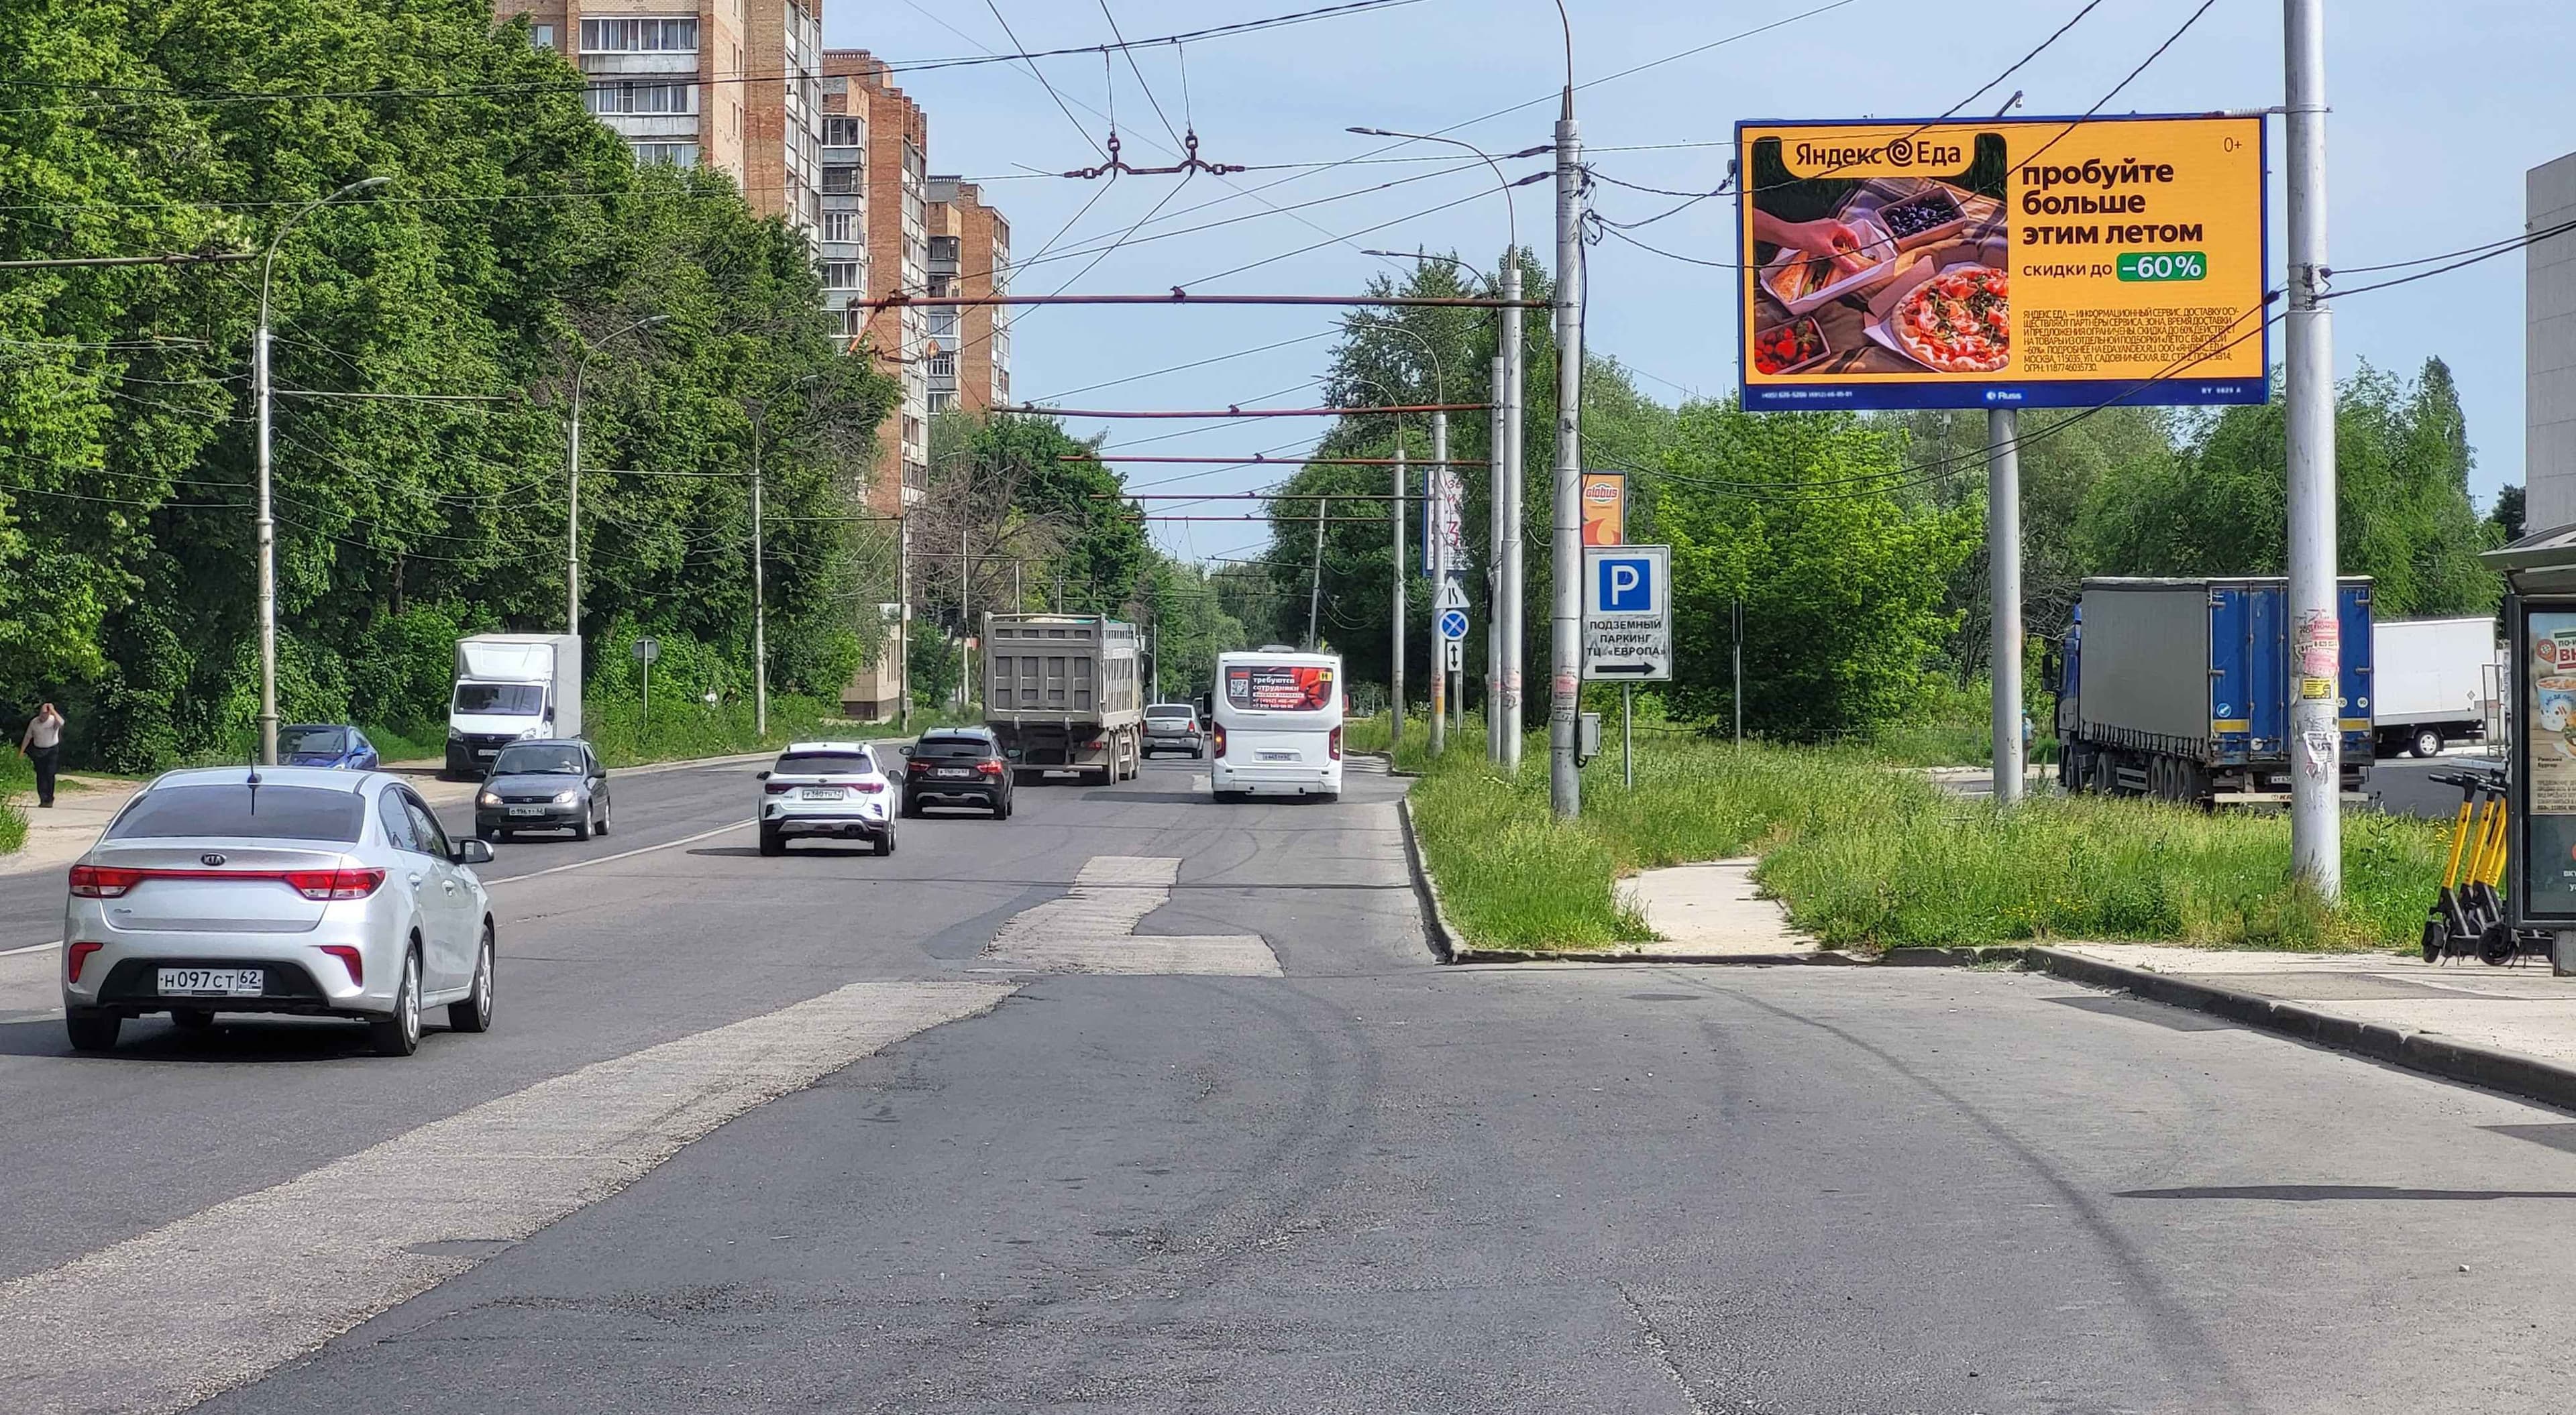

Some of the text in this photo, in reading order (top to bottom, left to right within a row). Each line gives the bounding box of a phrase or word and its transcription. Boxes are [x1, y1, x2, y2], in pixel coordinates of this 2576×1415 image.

[2223, 136, 2243, 153] 0+
[1796, 141, 1961, 168] Яндекс Еда
[2022, 157, 2174, 190] пробуйте
[2022, 189, 2146, 215] больше
[2023, 223, 2203, 245] этим летом
[2023, 264, 2087, 278] скидки
[2090, 263, 2112, 278] до
[2023, 309, 2051, 319] ЯНДЕКС
[2053, 309, 2068, 319] ЕДА
[2076, 307, 2151, 318] ИНФОРМАЦИОННЫЙ
[2184, 307, 2221, 317] ДОСТАВКУ
[2023, 319, 2069, 328] ЩЕСТВЛЯЮТ
[2167, 317, 2192, 326] ВРЕМЯ
[2193, 316, 2232, 326] ДОСТАВКИ
[2030, 327, 2086, 337] ПРЕДЛОЖЕНИЯ
[2137, 326, 2166, 335] СКИДКА
[2167, 326, 2179, 335] ДО
[2023, 336, 2034, 345] НА
[2035, 336, 2064, 345] ТОВАРЫ
[2065, 336, 2074, 345] ИЗ
[2075, 335, 2120, 345] ОТДЕЛЬНОЙ
[2121, 335, 2161, 344] ПОДБОРКИ
[2185, 334, 2190, 343] С
[2047, 345, 2091, 355] ПОДРОБНЕЕ
[2091, 345, 2102, 353] НА
[2157, 344, 2175, 353] ООО
[1998, 391, 2023, 400] Russ
[1586, 486, 1618, 498] globus
[1611, 565, 1640, 606] P
[1589, 618, 1662, 631] ПОДЗЕМНЫЙ
[1599, 634, 1652, 644] ПАРКИНГ
[1587, 646, 1666, 657] ТЦ «ЕВРОПА»
[1252, 677, 1295, 685] требуются
[203, 855, 223, 864] KIA
[240, 971, 258, 984] 62
